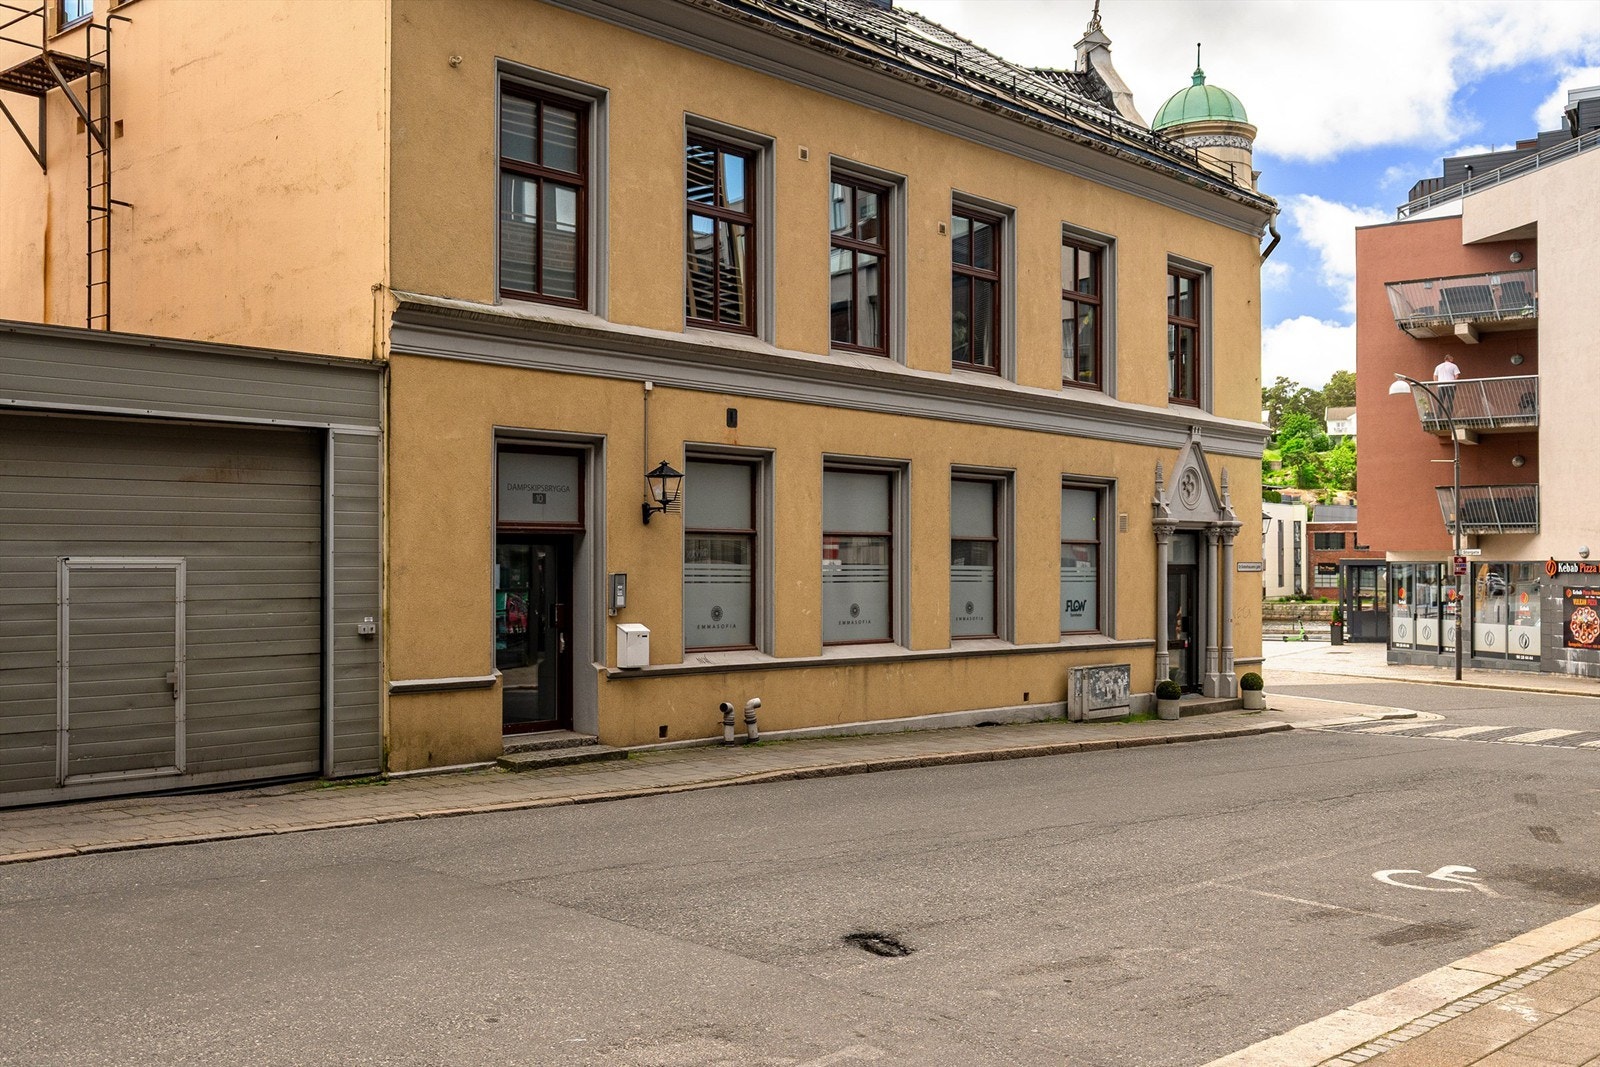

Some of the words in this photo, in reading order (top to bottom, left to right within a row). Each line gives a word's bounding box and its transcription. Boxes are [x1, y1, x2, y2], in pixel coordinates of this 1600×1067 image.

[506, 483, 571, 493] DAMPSKIPSBRYGGA
[1558, 562, 1579, 573] Kebab
[1579, 562, 1597, 573] Pizza
[1065, 599, 1087, 612] FLOW
